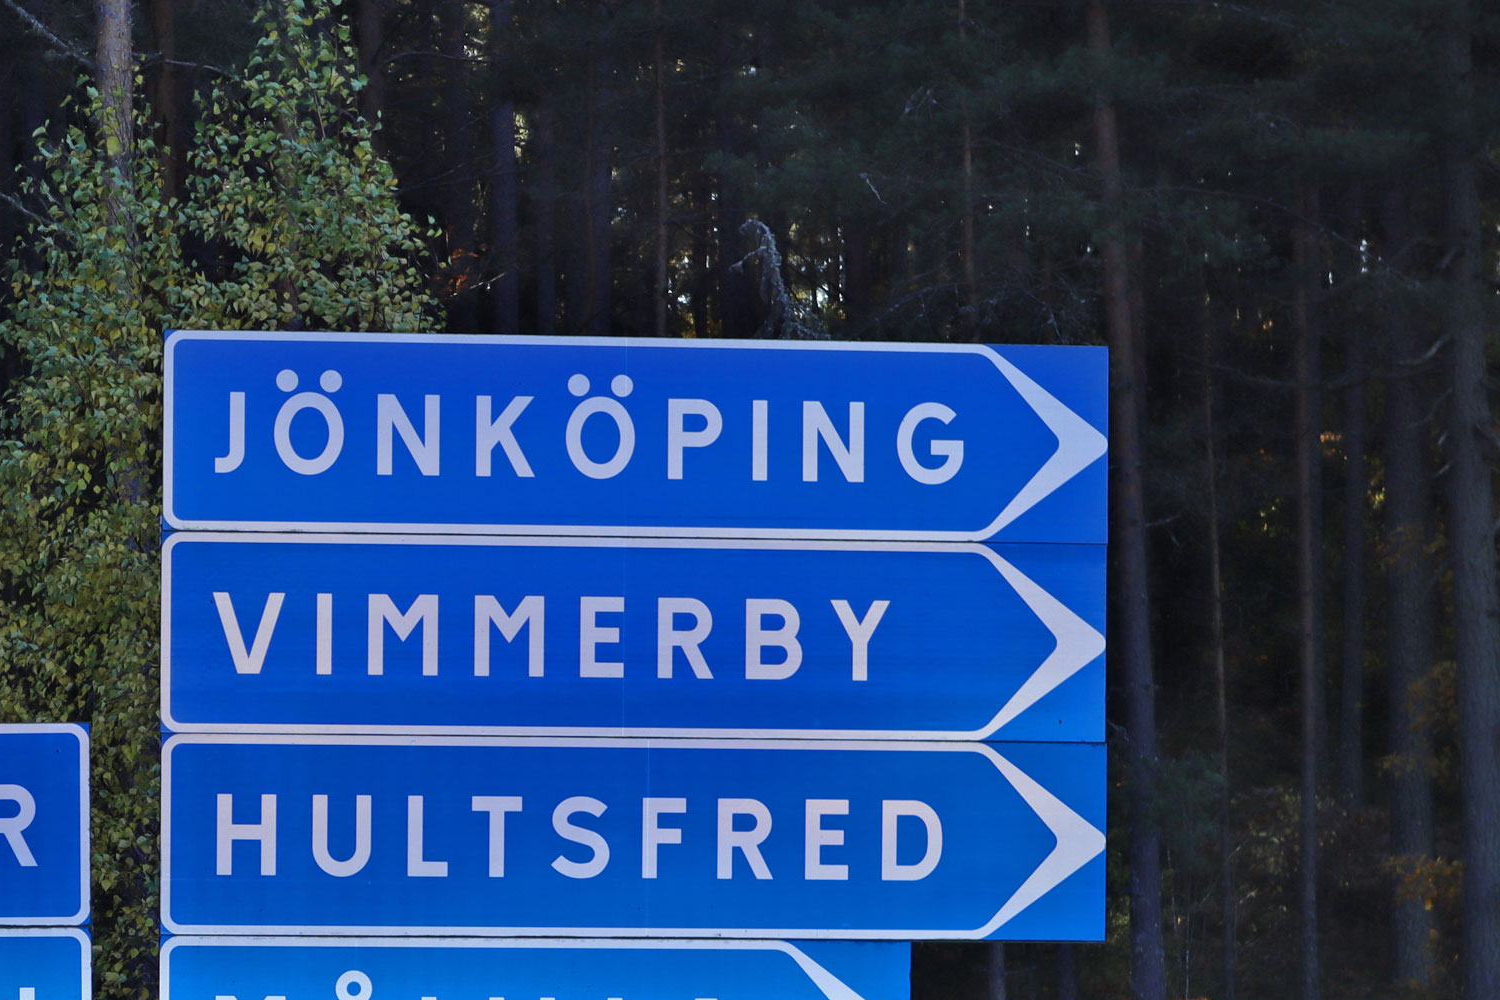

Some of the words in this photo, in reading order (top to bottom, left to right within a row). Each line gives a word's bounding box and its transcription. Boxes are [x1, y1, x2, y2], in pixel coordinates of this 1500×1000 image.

[214, 369, 964, 485] JÖNKÖPING
[212, 591, 890, 682] VIMMERBY
[216, 793, 943, 881] HULTSFRED
